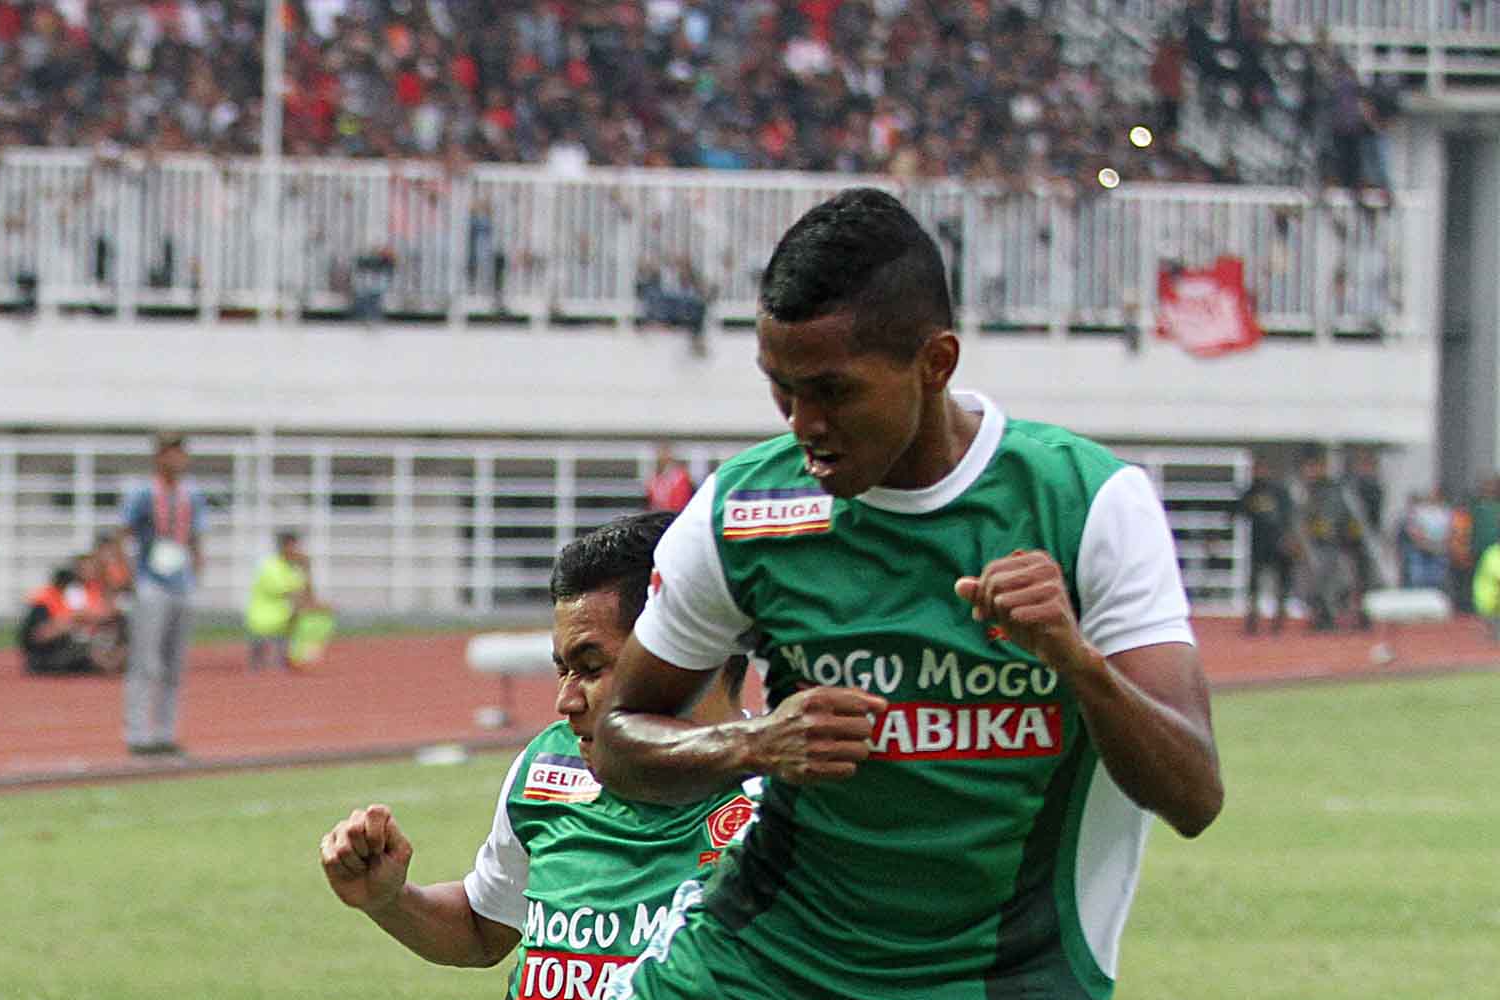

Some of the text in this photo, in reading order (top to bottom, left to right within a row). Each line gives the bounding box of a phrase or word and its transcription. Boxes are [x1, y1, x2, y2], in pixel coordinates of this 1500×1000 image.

[731, 502, 822, 521] GELIGA
[917, 647, 1058, 699] MOGU
[523, 900, 620, 949] MOGU
